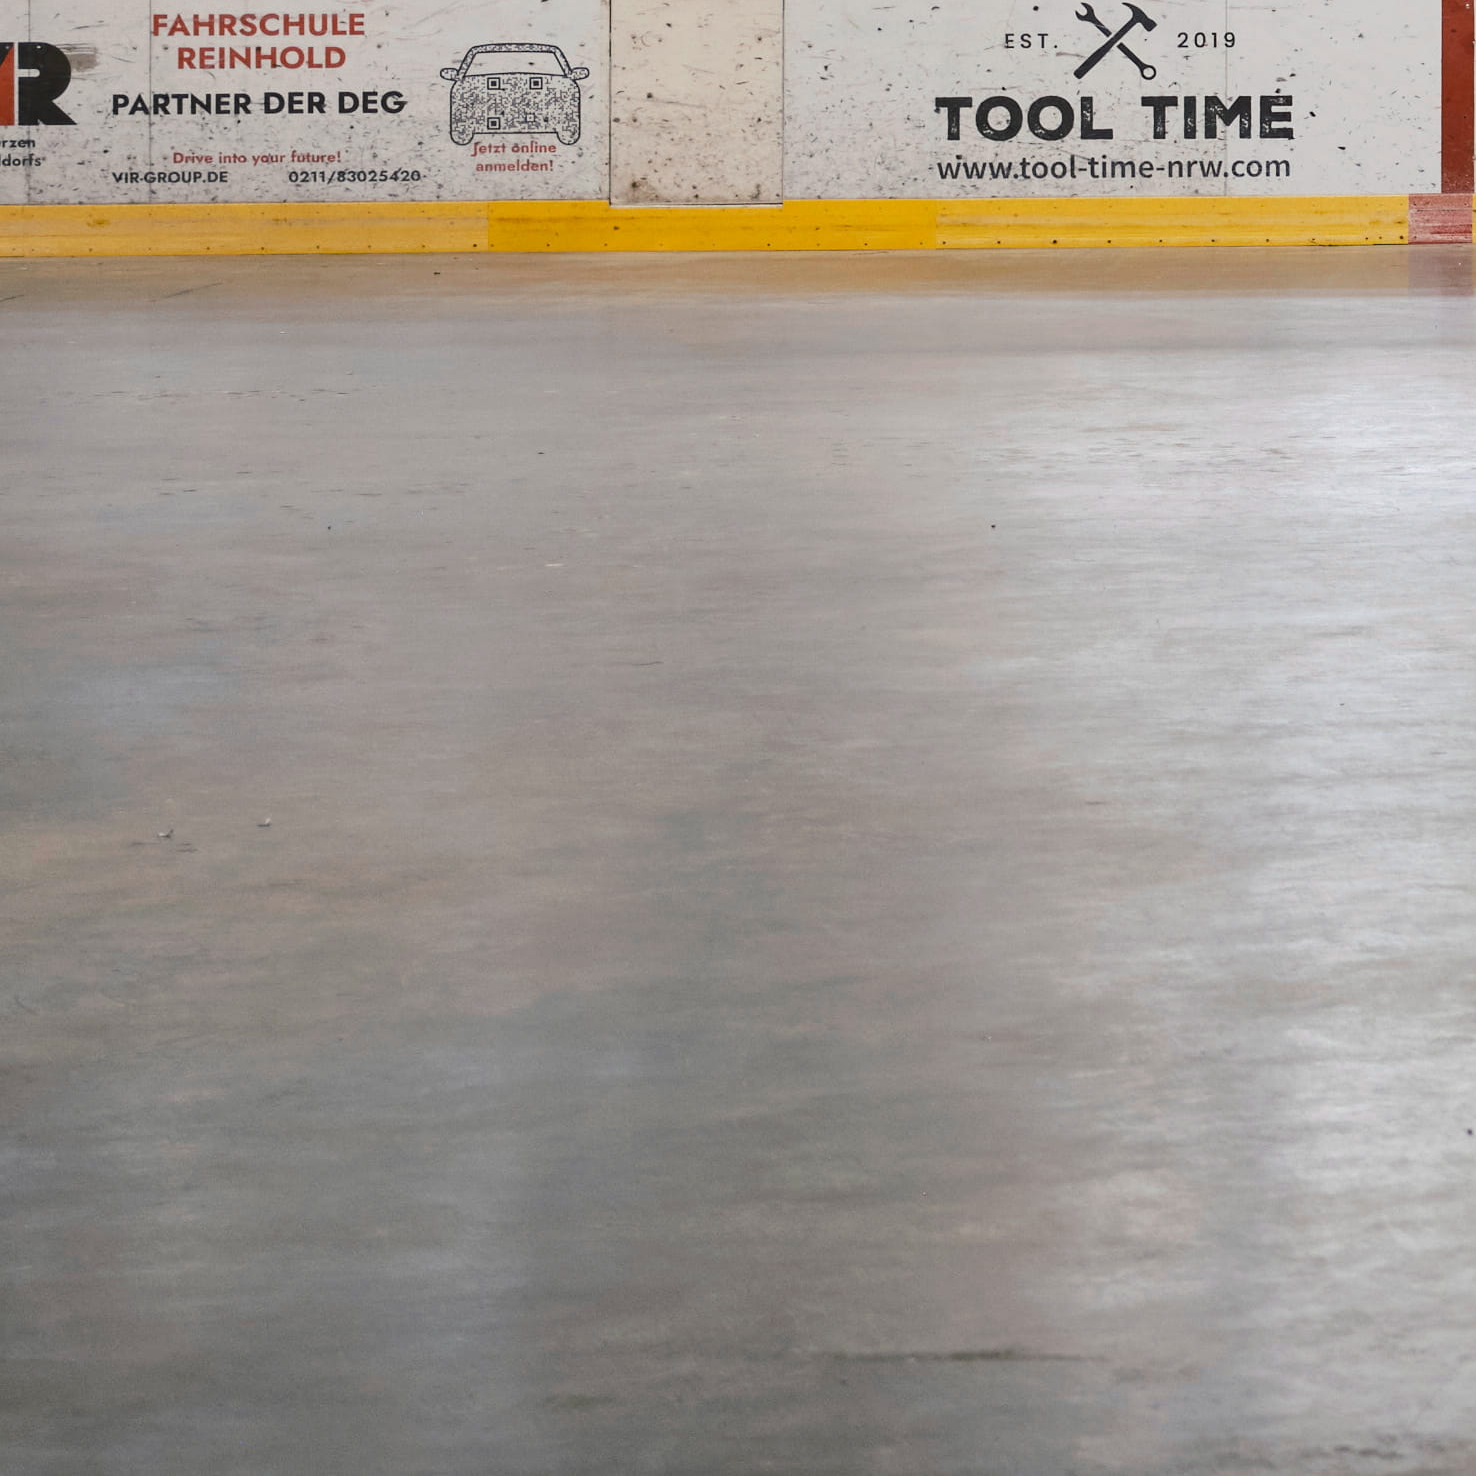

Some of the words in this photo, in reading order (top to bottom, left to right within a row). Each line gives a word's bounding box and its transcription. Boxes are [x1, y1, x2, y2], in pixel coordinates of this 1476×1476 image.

[152, 13, 365, 37] FAHRSCHULE
[1005, 34, 1058, 49] EST.
[1177, 33, 1236, 48] 2019
[177, 46, 346, 70] REINHOLD
[112, 93, 251, 116] PARTNER
[264, 92, 326, 115] DER
[338, 91, 406, 115] DEG
[935, 95, 1113, 141] TOOL
[1141, 95, 1294, 139] TIME
[471, 142, 505, 157] Jetzt
[511, 140, 557, 154] online
[173, 152, 214, 164] Drive
[219, 152, 247, 164] into
[252, 154, 287, 167] your
[290, 151, 342, 164] future!
[475, 160, 554, 172] anmelden!
[937, 154, 1291, 180] www.tool-time-nrw.com
[112, 171, 228, 184] VIR-GROUP.DE
